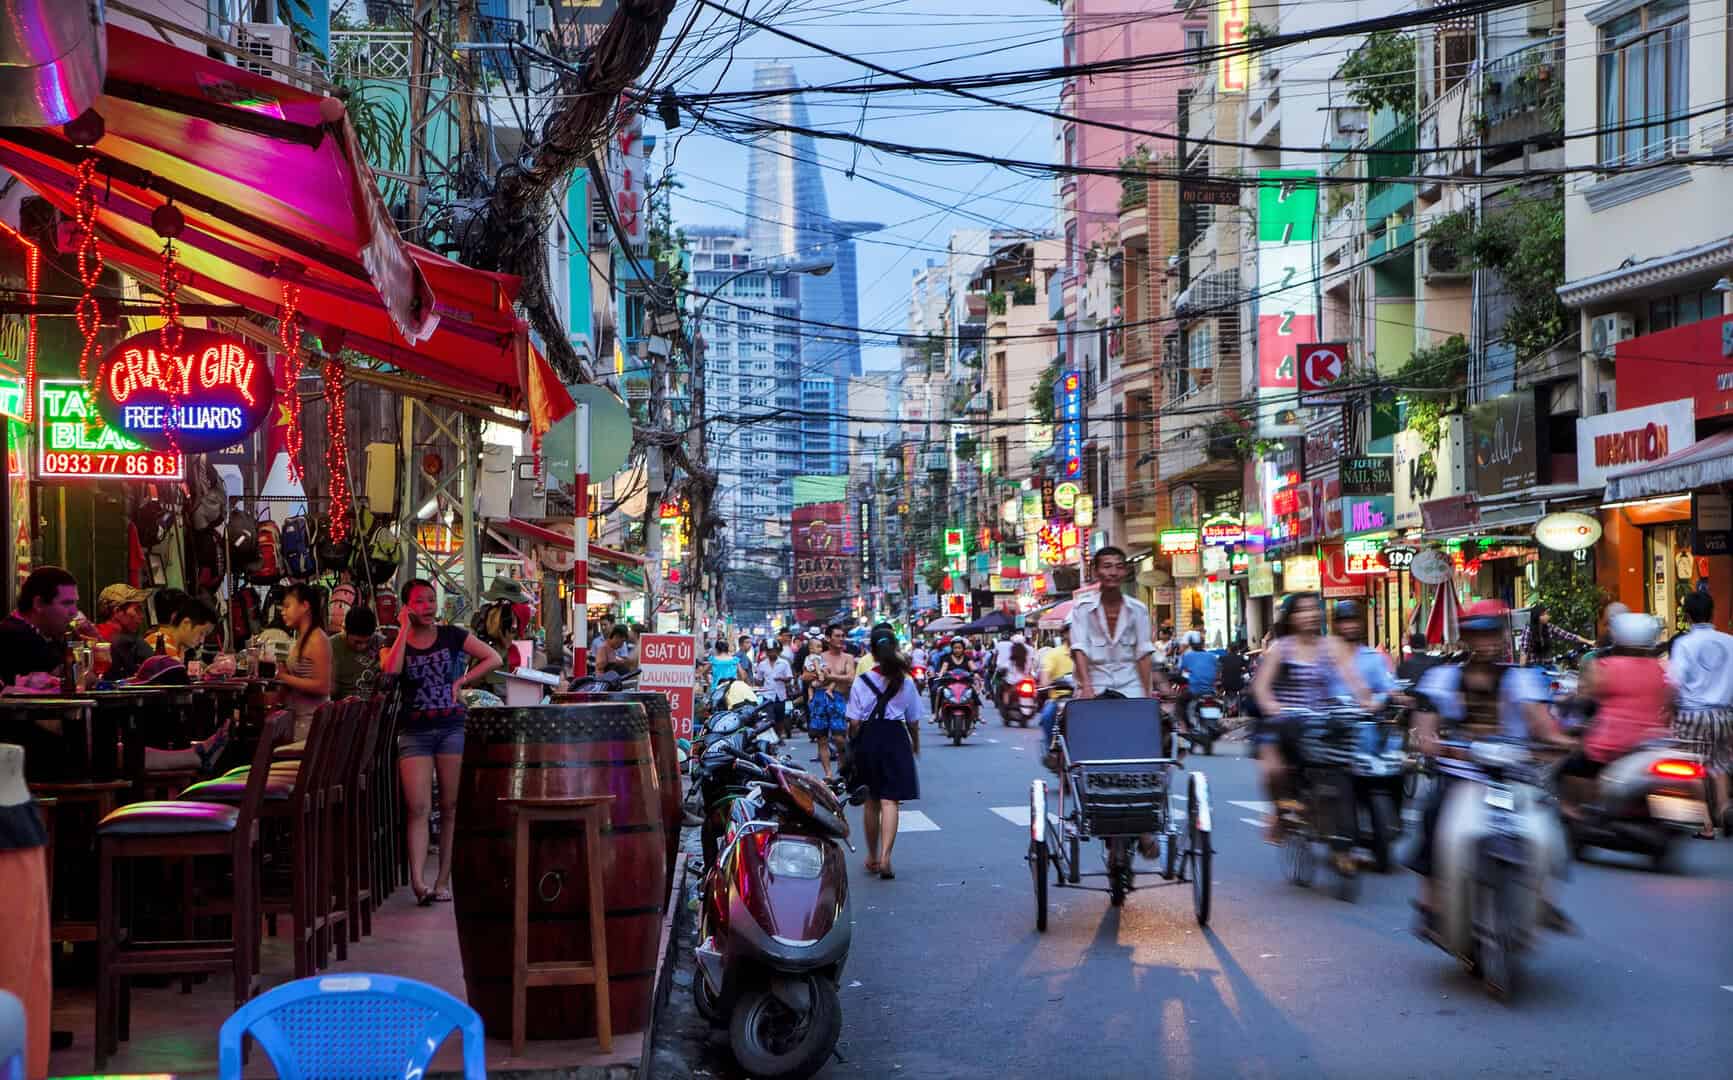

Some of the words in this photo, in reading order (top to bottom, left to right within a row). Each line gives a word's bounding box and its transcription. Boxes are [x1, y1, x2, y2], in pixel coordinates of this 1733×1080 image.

[200, 343, 255, 406] GIRL
[1311, 355, 1339, 382] K
[124, 406, 164, 428] FREE
[46, 454, 91, 473] 0933
[97, 455, 119, 473] 77
[125, 456, 148, 474] 86
[1344, 470, 1367, 484] NAIL
[1372, 468, 1392, 483] SPA
[645, 644, 675, 662] GIẶT
